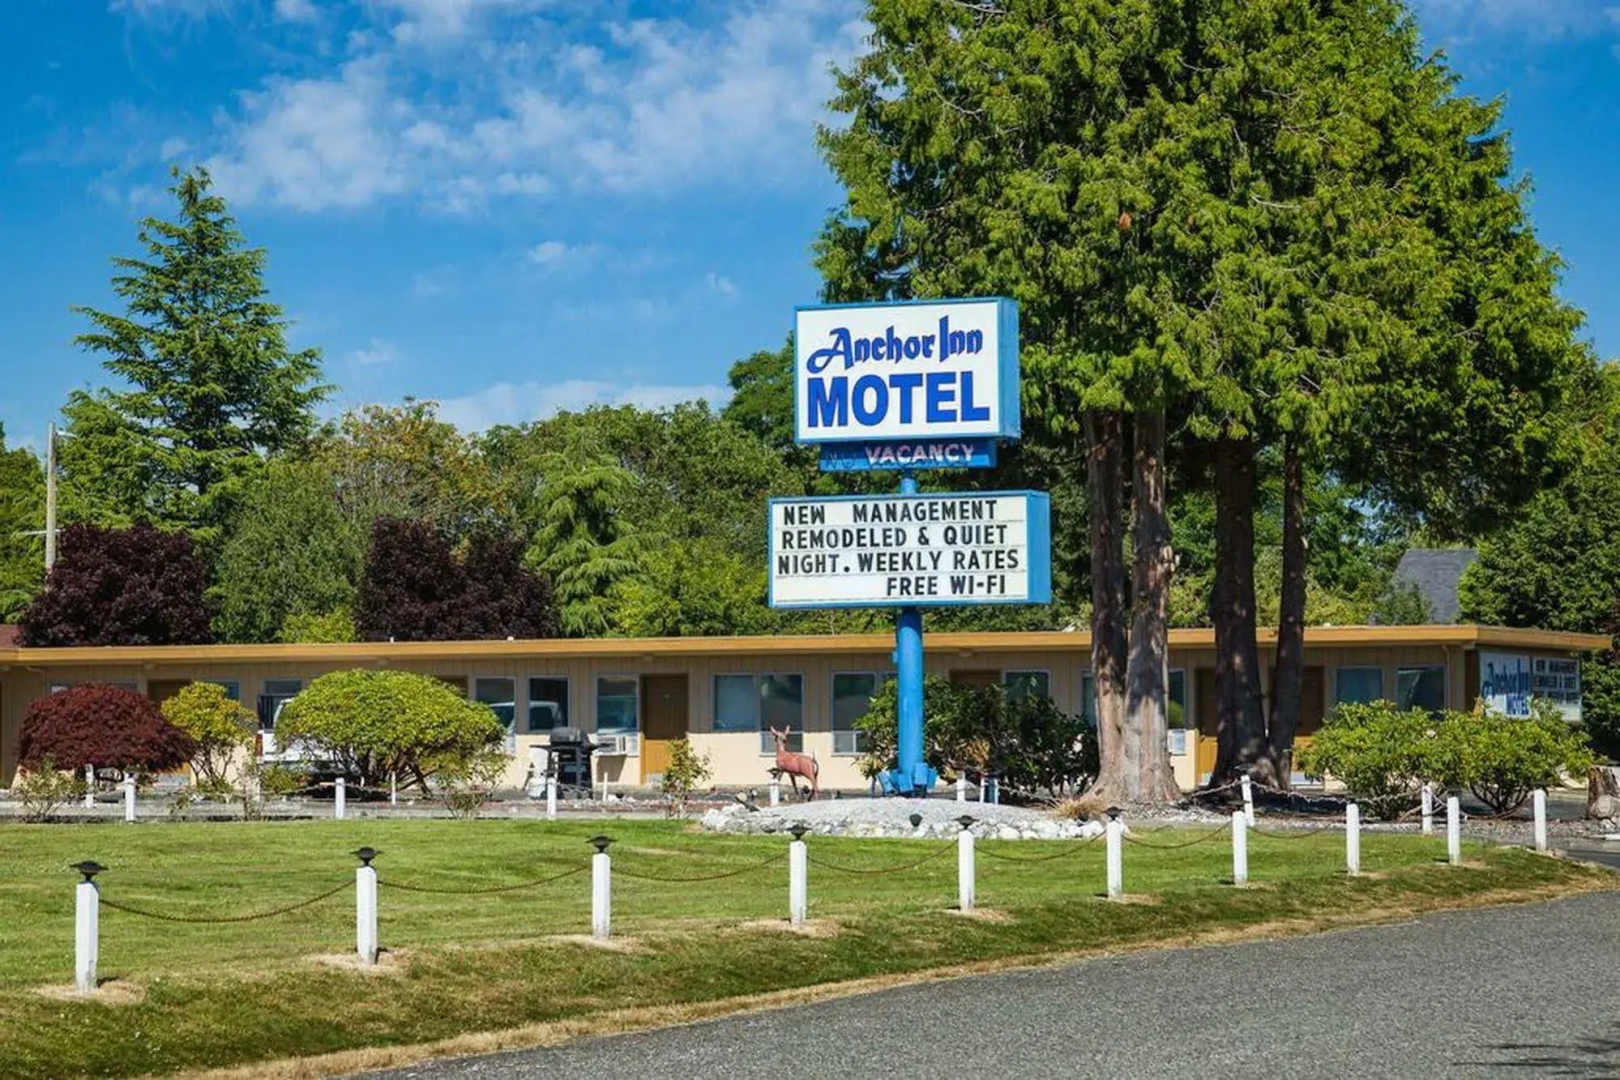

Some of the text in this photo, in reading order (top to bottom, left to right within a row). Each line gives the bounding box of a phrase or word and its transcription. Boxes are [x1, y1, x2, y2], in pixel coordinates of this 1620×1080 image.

[806, 315, 983, 374] Anchor Inn
[808, 371, 990, 428] MOTEL
[865, 444, 974, 465] VACANCY
[783, 500, 997, 526] NEW MANAGEMENT
[782, 525, 1008, 549] REMODELED & QUIET
[857, 551, 942, 572] WEEKLY
[953, 549, 1019, 570] RATES
[886, 575, 1005, 596] FREE WI-FI
